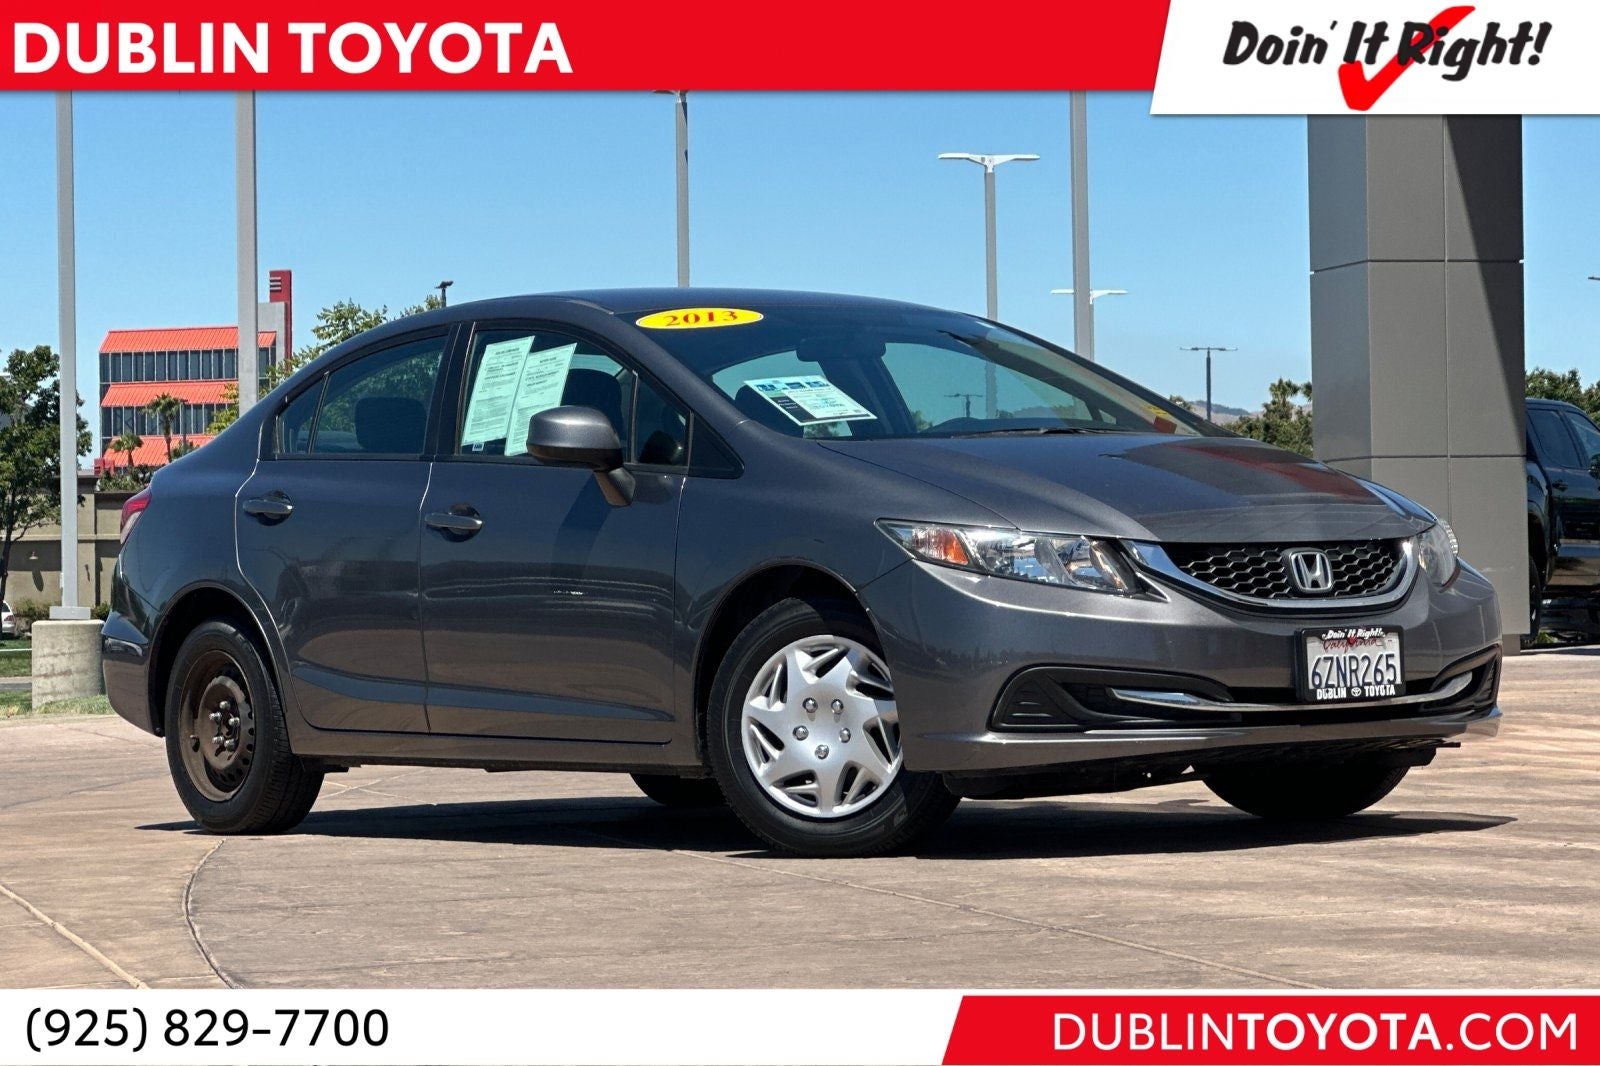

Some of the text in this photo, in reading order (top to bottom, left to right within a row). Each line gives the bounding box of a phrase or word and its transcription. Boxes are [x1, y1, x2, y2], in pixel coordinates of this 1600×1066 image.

[664, 311, 738, 326] 2013
[1323, 638, 1377, 653] Califrnia
[1311, 654, 1397, 689] 6ZNR265
[1316, 685, 1396, 700] DUBLIN TOYOTA
